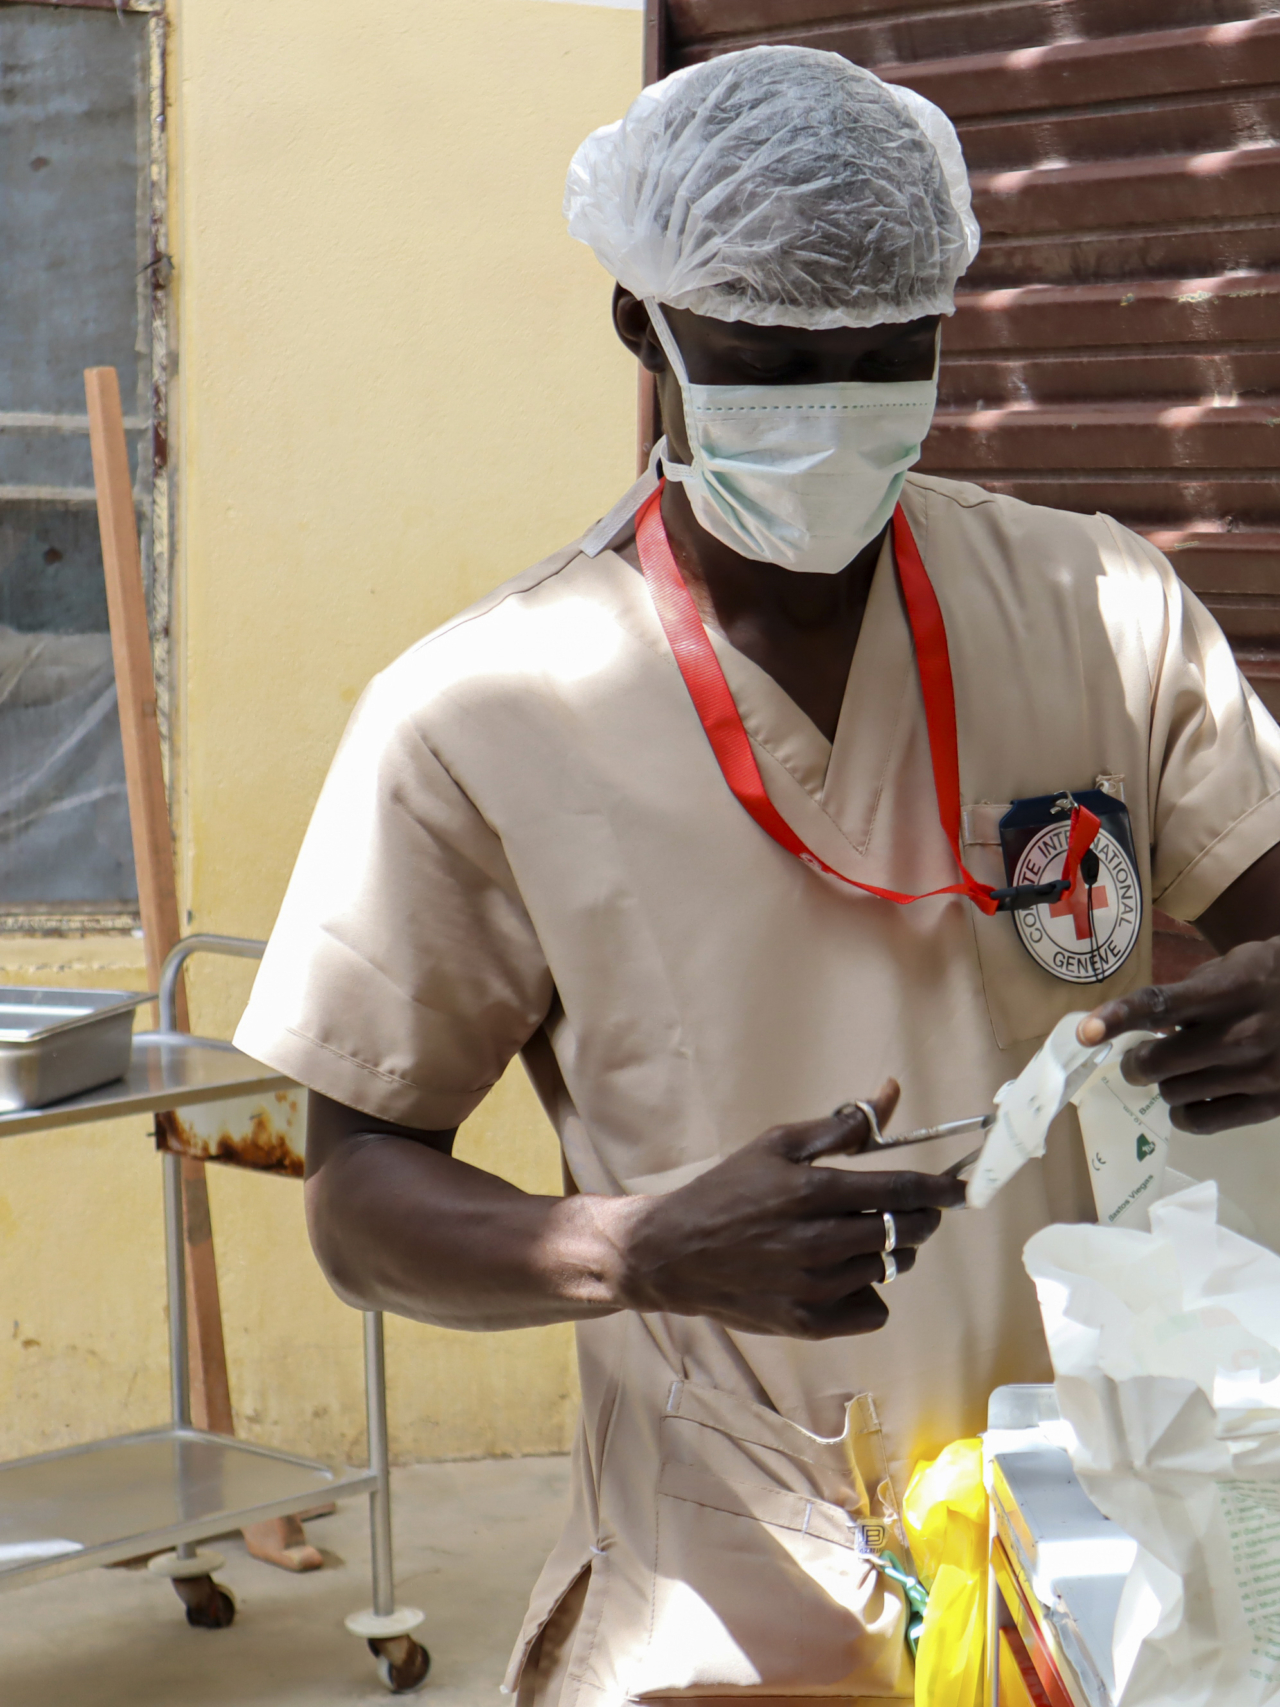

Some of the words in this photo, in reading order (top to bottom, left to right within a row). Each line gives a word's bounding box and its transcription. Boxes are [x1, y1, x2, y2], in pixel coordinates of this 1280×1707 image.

[1021, 858, 1043, 944] COTE
[1037, 829, 1134, 928] INTENATIONAL
[1053, 939, 1121, 975] GENEVE
[1138, 1093, 1161, 1116] Basto
[1107, 1197, 1131, 1223] Bastos
[1129, 1174, 1154, 1199] Viegas
